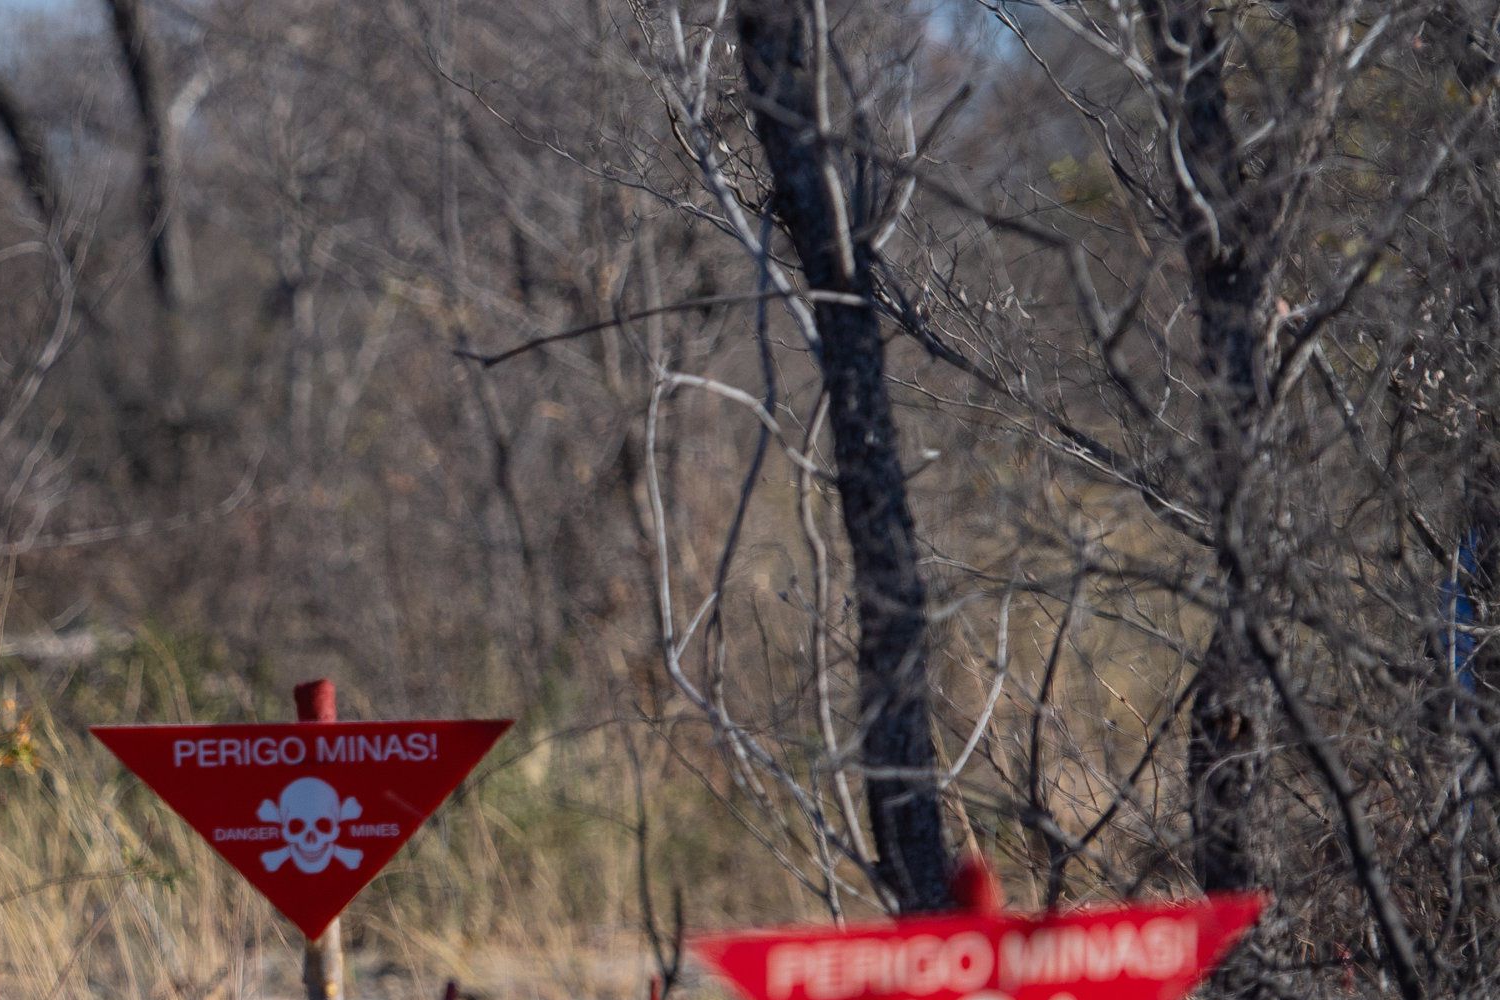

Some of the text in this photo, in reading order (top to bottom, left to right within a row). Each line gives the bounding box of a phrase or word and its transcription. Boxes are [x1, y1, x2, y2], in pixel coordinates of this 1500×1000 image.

[173, 732, 438, 768] PERIGO MINAS!
[214, 824, 399, 841] DANGER MINES
[766, 931, 994, 1000] PERIGO
